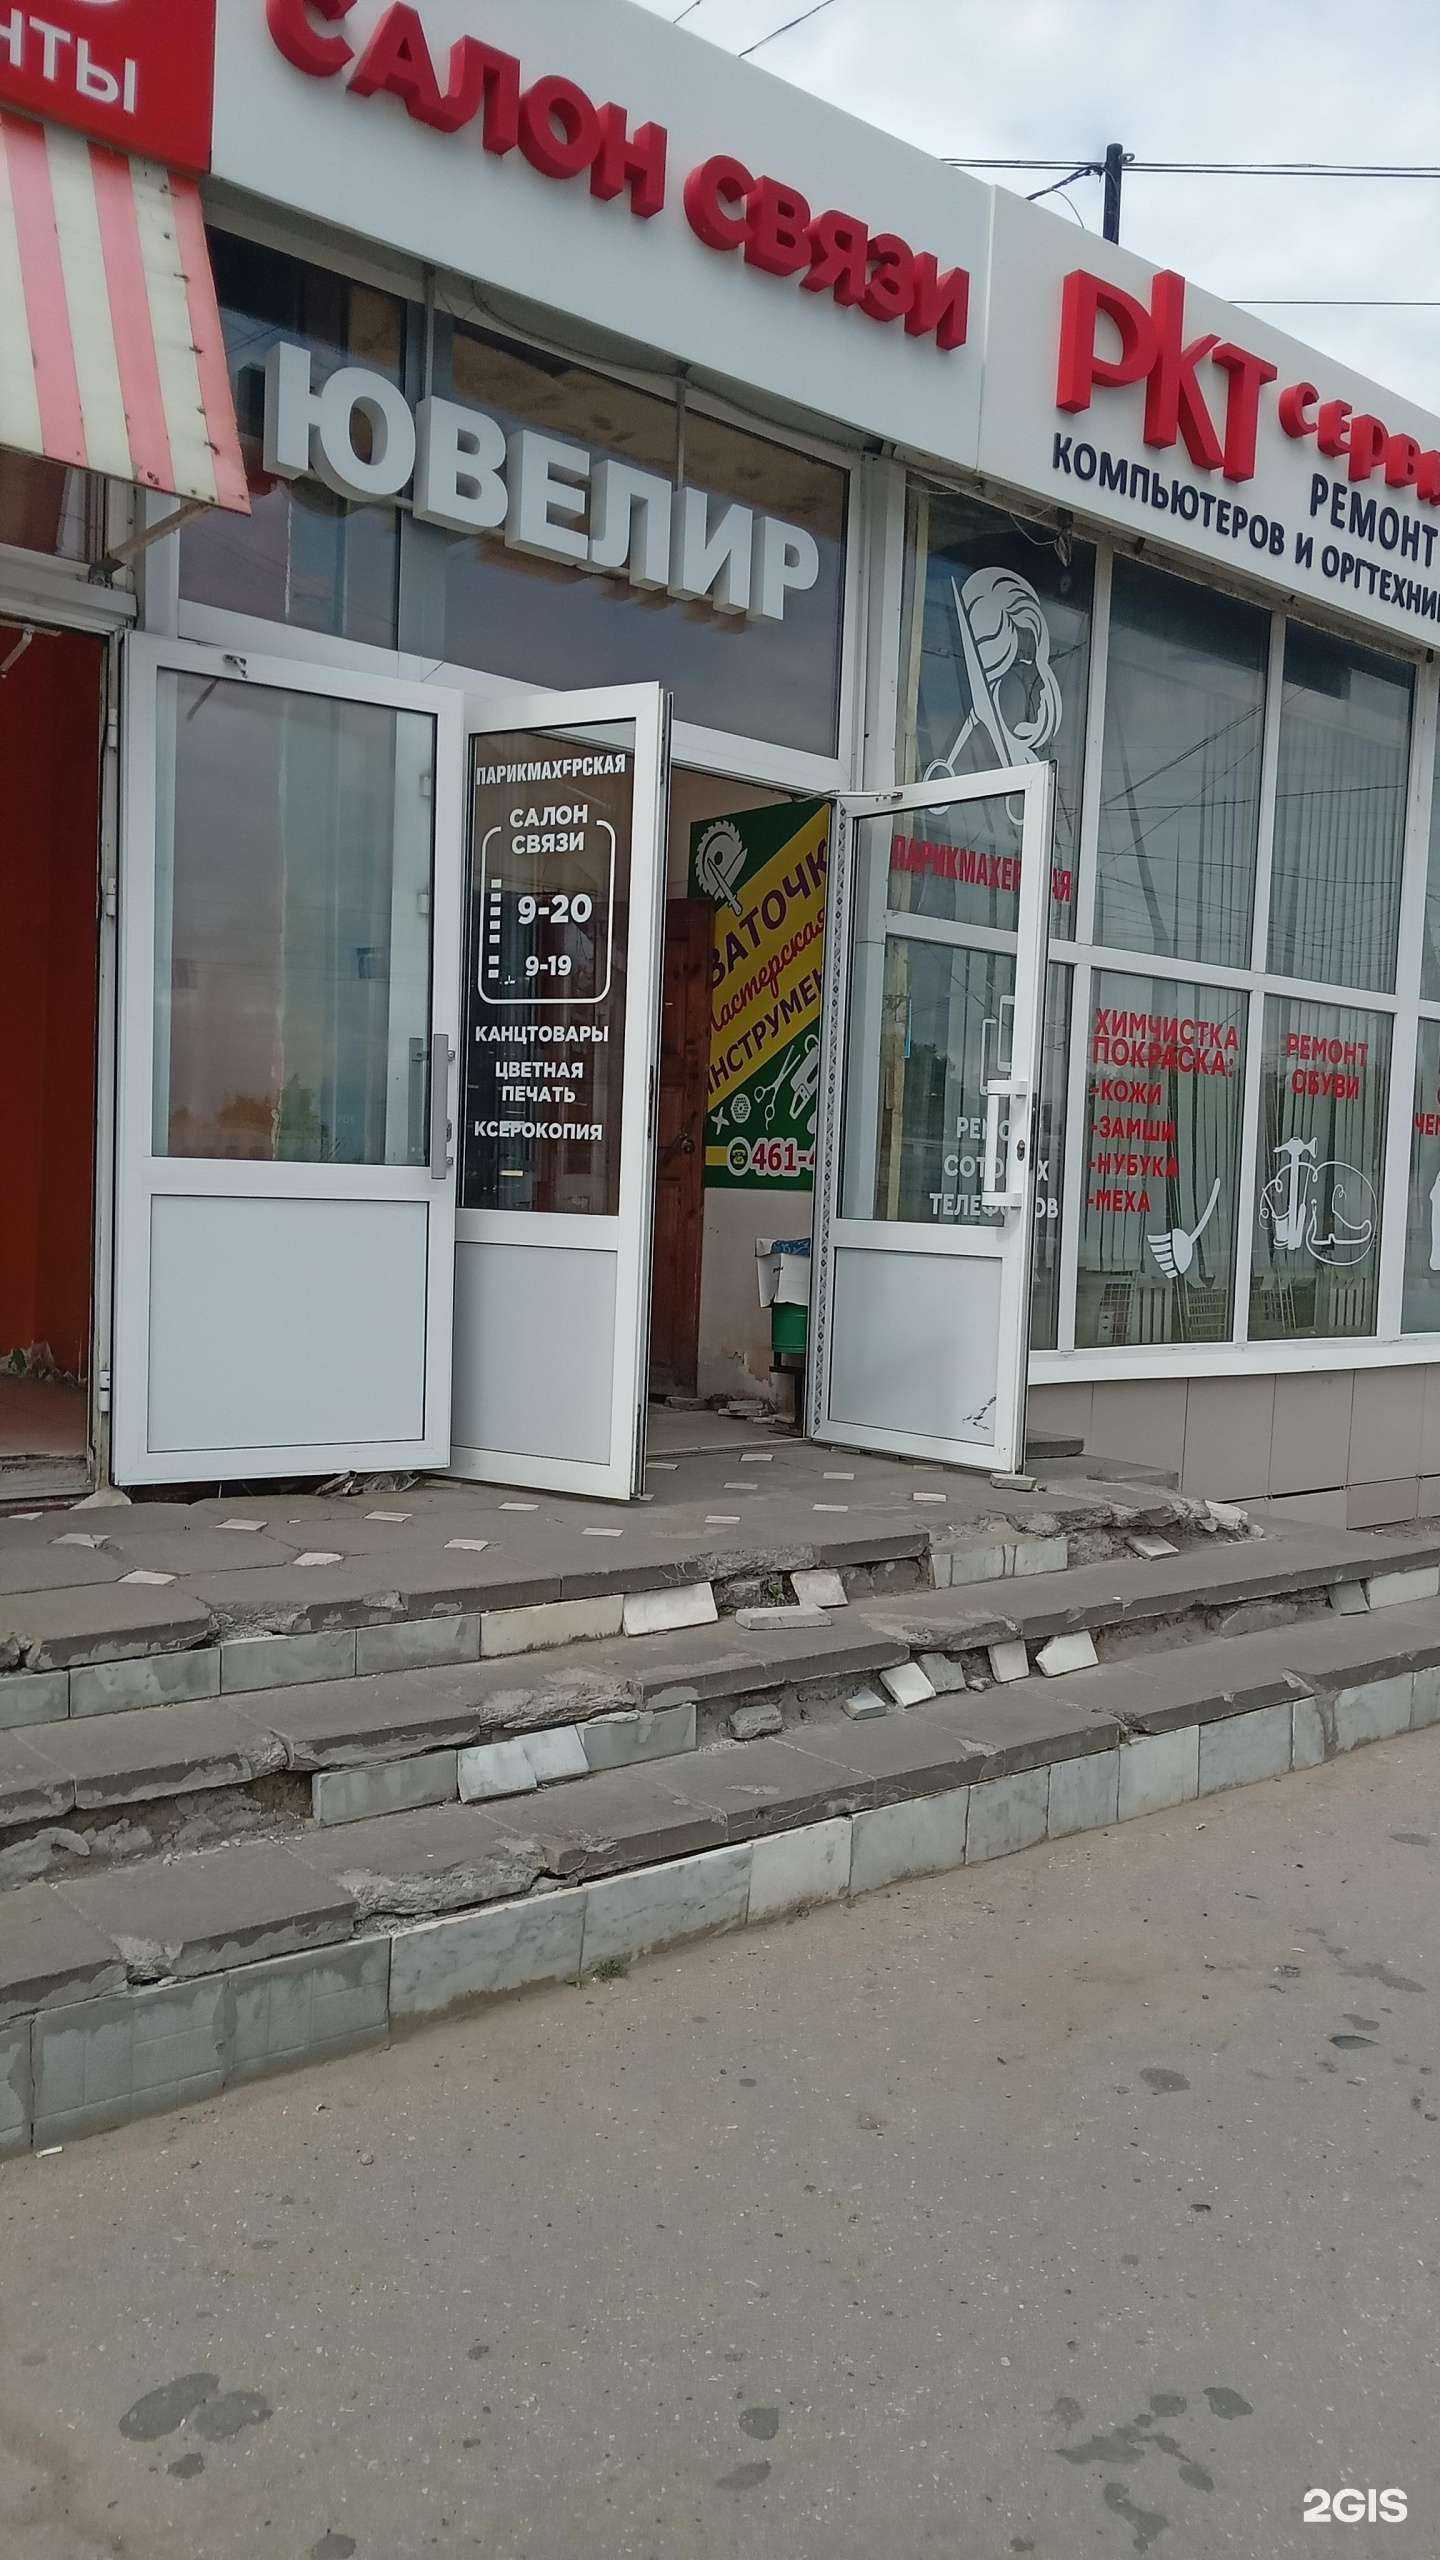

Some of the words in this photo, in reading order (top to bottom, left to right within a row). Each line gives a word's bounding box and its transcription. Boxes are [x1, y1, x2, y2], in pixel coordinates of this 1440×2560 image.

[266, 0, 667, 219] САЛОН
[684, 155, 970, 351] СВЯЗИ
[263, 341, 819, 622] ЮВЕЛИР
[1053, 432, 1284, 555] КОМПЬЮТЕРОВ
[1294, 532, 1314, 568] И
[1310, 472, 1438, 567] РЕМОНТ
[509, 804, 588, 828] САЛОН
[511, 831, 585, 855] СВЯЗИ
[517, 893, 593, 925] 9-20
[525, 955, 572, 977] 9-19
[475, 1025, 609, 1045] КАНЦТОВАРЫ
[1095, 1008, 1238, 1050] ХИМЧИСТКА
[1092, 1036, 1235, 1078] ПОКРАСКА:
[1286, 1032, 1369, 1067] РЕМОНТ
[495, 1061, 584, 1080] ЦВЕТНАЯ
[1291, 1068, 1359, 1100] ОБУВИ
[501, 1086, 576, 1103] ПЕЧАТЬ
[474, 1120, 603, 1141] КСЕРОКОПИЯ
